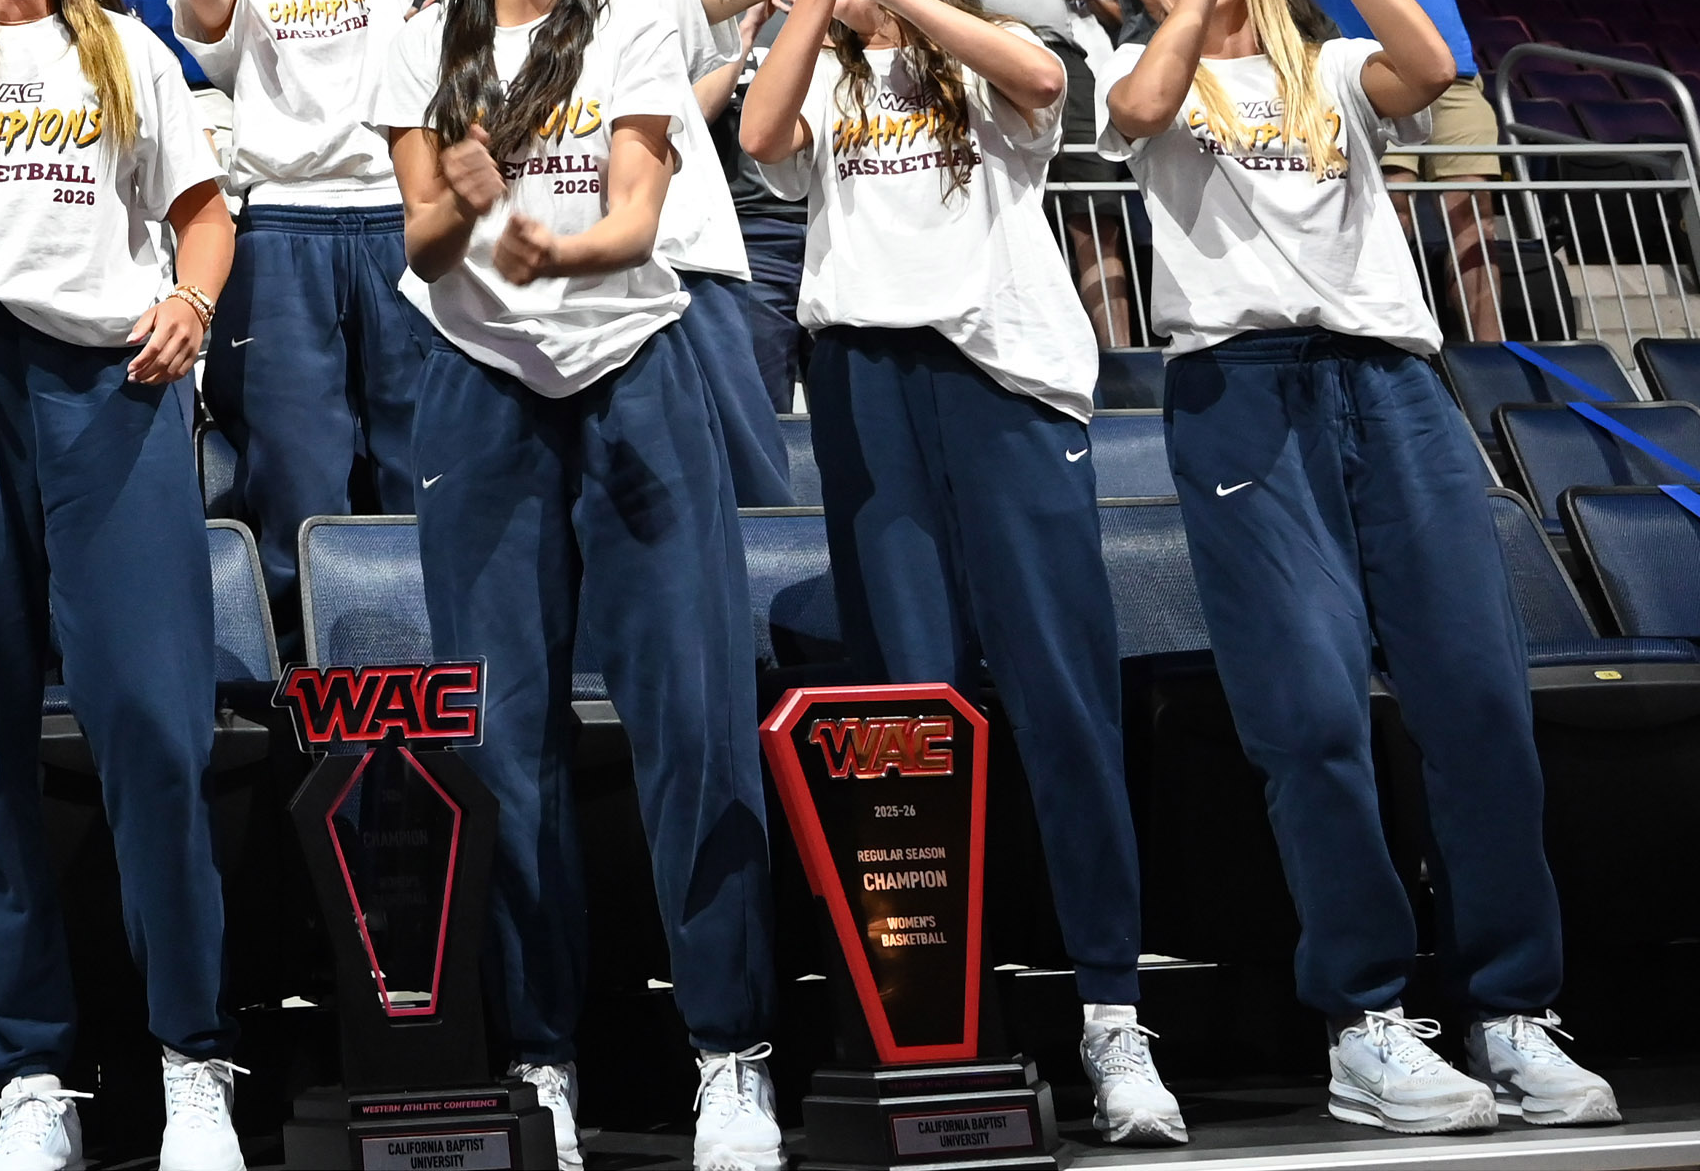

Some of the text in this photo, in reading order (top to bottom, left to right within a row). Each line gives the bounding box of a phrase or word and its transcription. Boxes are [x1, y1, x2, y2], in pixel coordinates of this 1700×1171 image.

[553, 179, 600, 195] 2026
[52, 189, 96, 205] 2026
[284, 664, 479, 743] WAC
[809, 715, 954, 780] WAC
[873, 804, 916, 818] 2025-26
[857, 847, 946, 863] REGULAR SEASON
[863, 869, 948, 891] CHAMPION
[886, 915, 936, 930] WOMEN'S
[881, 932, 948, 948] BASKETBALL
[362, 1099, 498, 1114] WESTERN ATHLETIC CONFERENCE
[918, 1116, 1007, 1134] CALIFORNIA BAPTIST
[388, 1138, 485, 1155] CALIFORNIA BAPTIST
[940, 1131, 990, 1148] UNIVERSITY
[410, 1154, 465, 1170] UNIVERSITY
